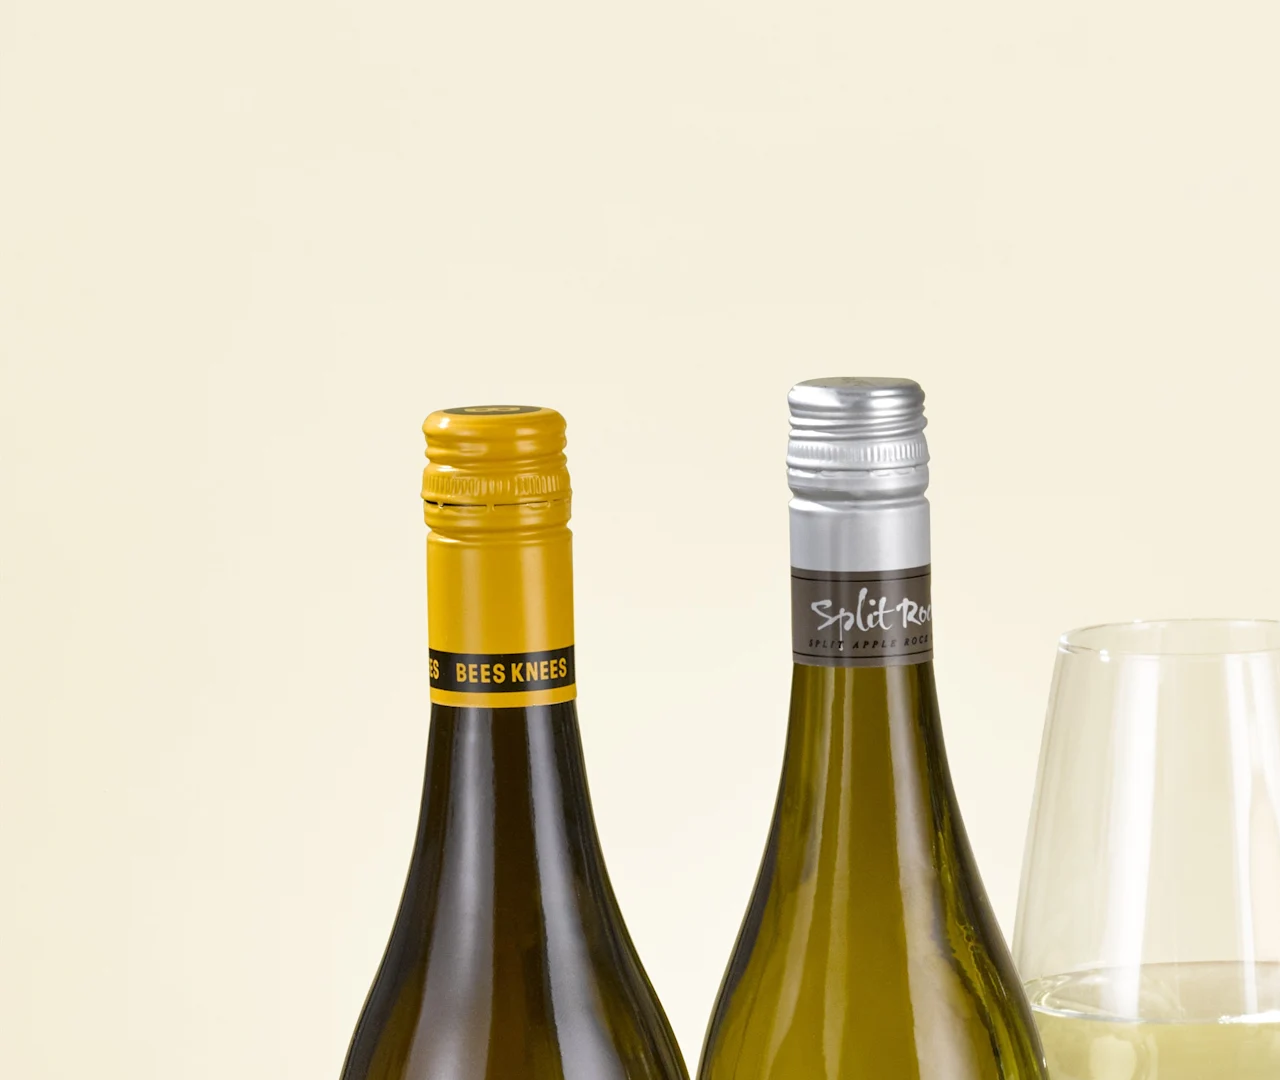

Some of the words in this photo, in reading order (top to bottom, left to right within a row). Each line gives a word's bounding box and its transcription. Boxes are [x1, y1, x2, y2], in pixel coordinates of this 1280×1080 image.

[810, 587, 895, 651] Split
[896, 597, 932, 629] Roc
[809, 638, 845, 649] SPLIT
[852, 639, 898, 649] APPLE
[455, 662, 506, 684] BEES
[511, 657, 567, 683] KNEES
